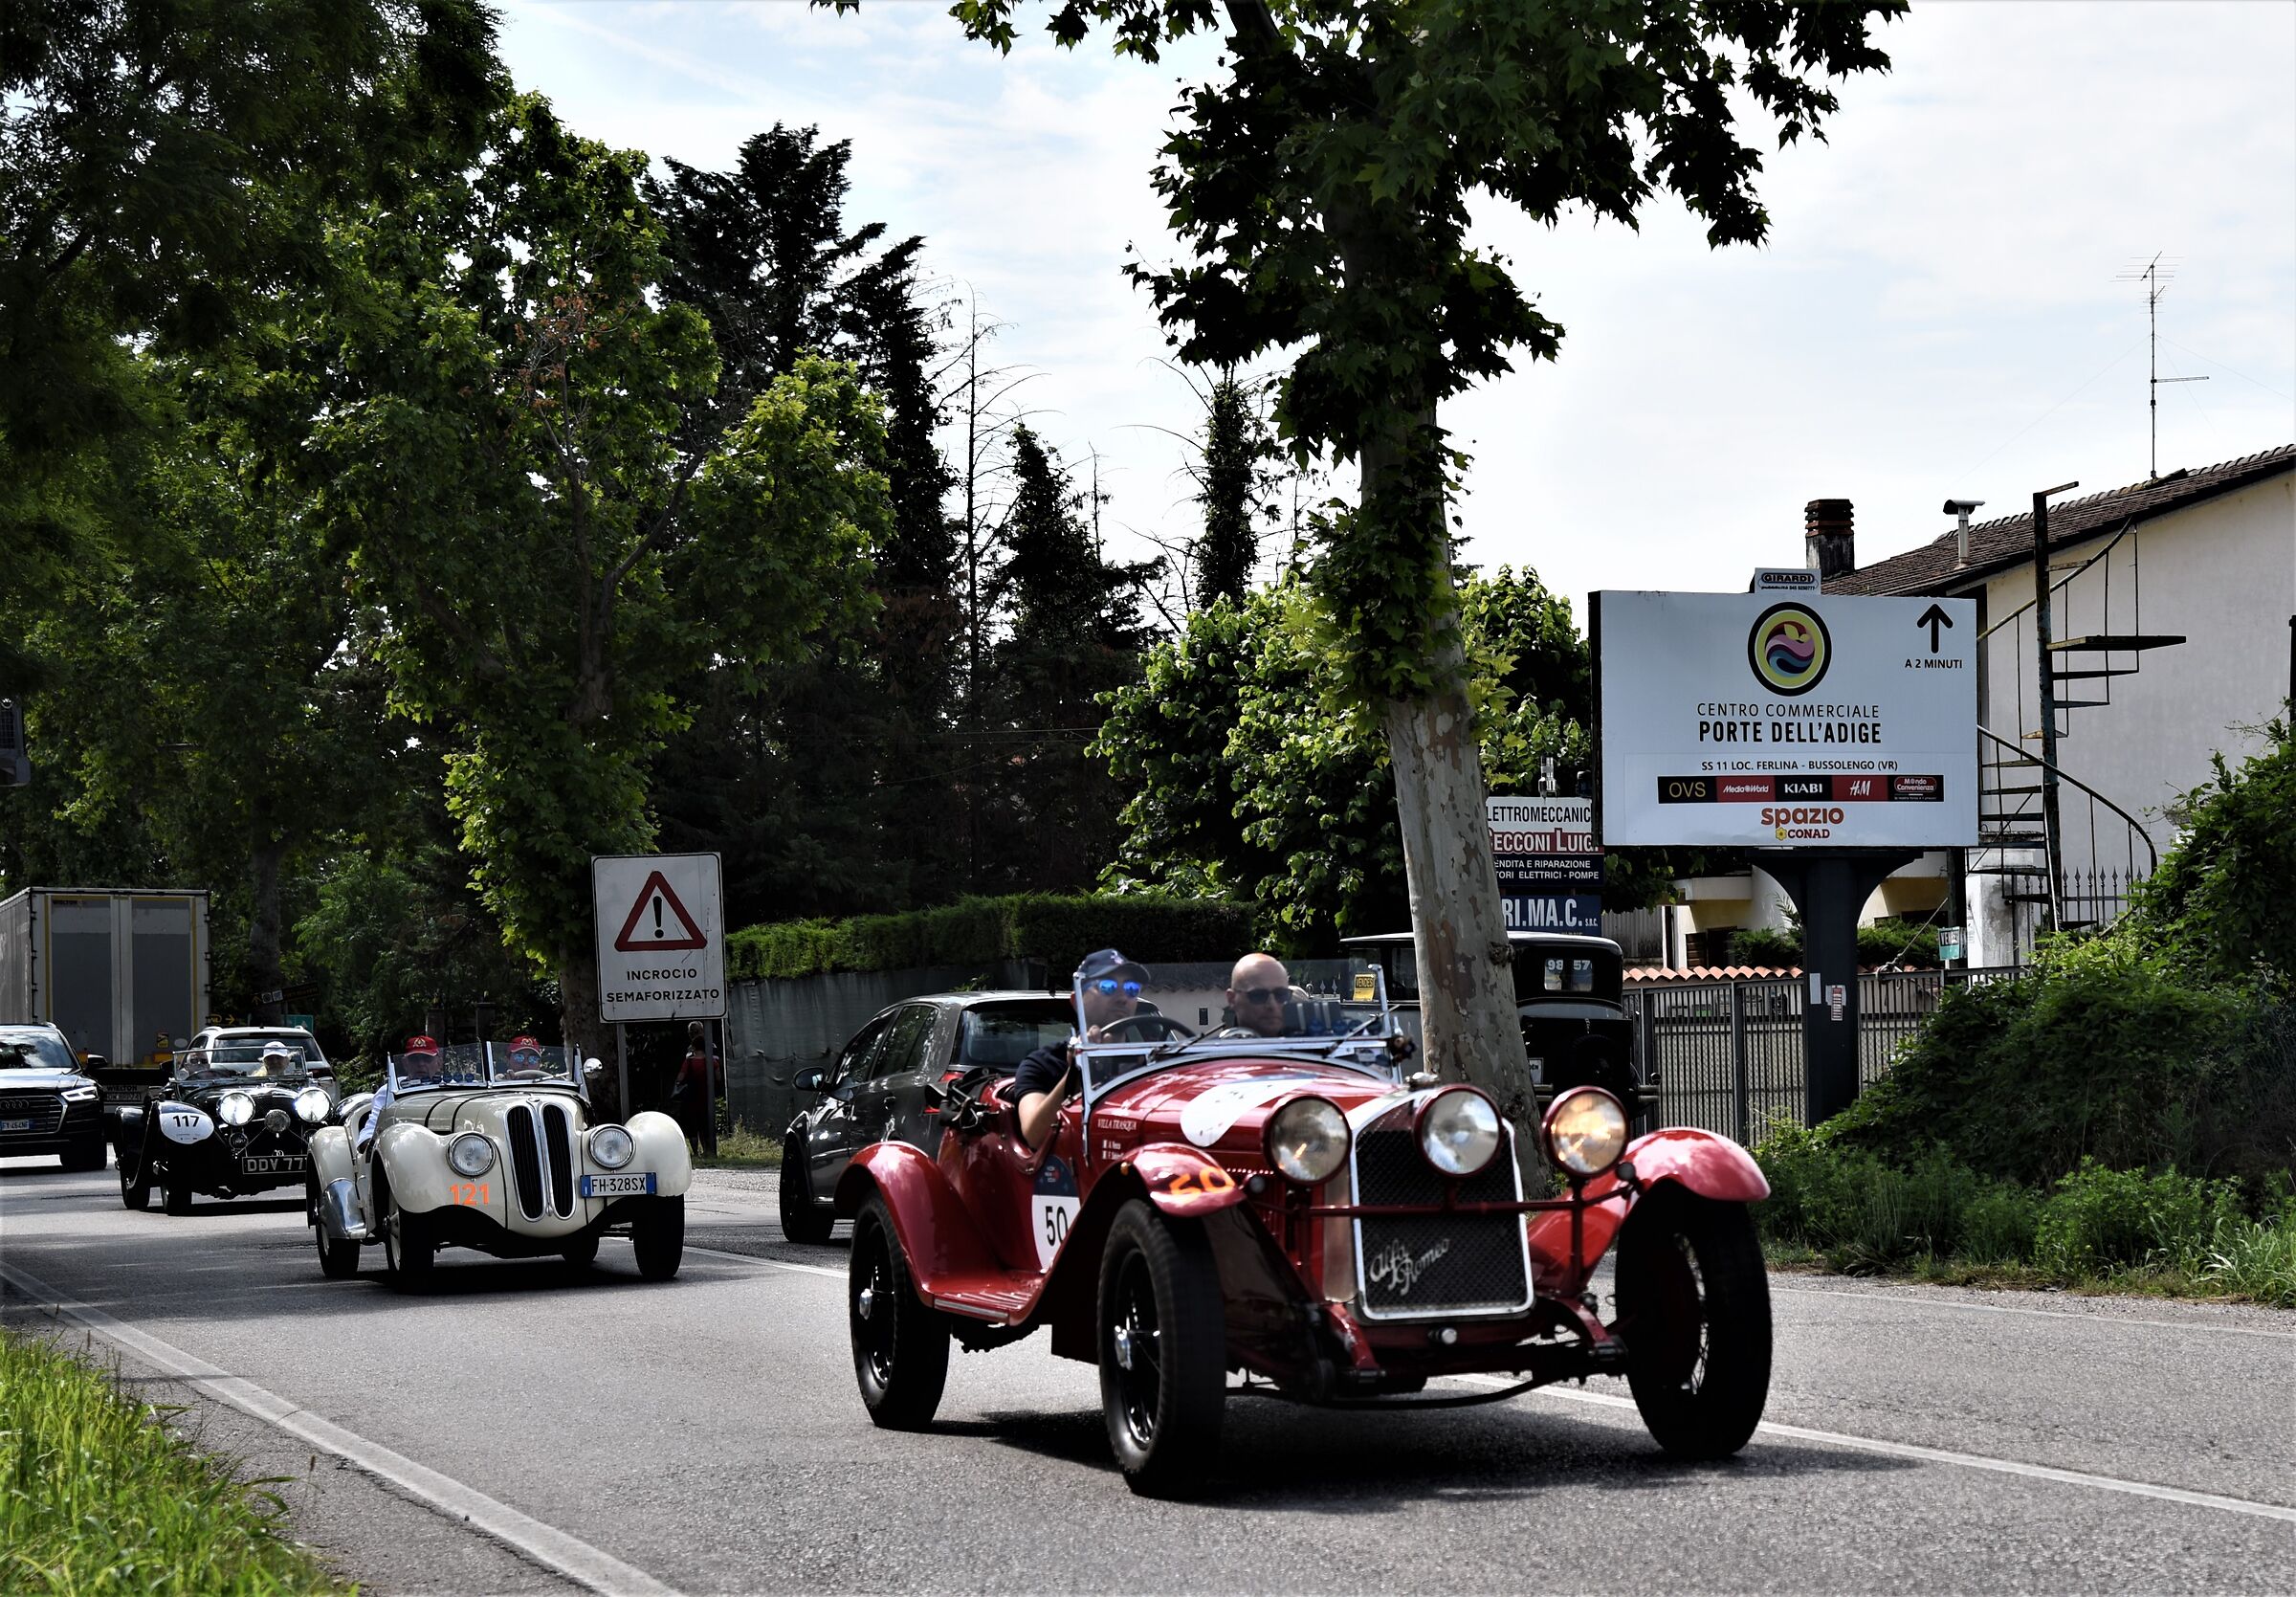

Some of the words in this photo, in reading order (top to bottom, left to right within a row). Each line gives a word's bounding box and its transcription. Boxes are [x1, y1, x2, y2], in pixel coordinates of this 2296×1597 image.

[1905, 659, 1912, 669] A
[1915, 659, 1921, 669] 2
[1925, 659, 1962, 669] MINUTI
[1697, 703, 1759, 717] CENTRO
[1766, 704, 1879, 718] COMMERCIALE
[1699, 721, 1763, 743] PORTE
[1772, 721, 1882, 743] DELL'ADIGE
[1702, 762, 1713, 770] SS
[1717, 762, 1728, 770] 11
[1732, 762, 1754, 770] LOC.
[1757, 761, 1799, 769] FERLINA
[1809, 761, 1874, 770] BUSSOLENGO
[1878, 761, 1898, 771] (VR)
[1669, 782, 1706, 798] OVS
[1784, 784, 1822, 793] KIABI
[1486, 807, 1591, 822] LETTROMECCANIC
[1761, 808, 1843, 829] spazio
[1489, 830, 1550, 852] ECCONI
[1556, 830, 1599, 852] LUIG
[1787, 829, 1830, 838] CONAD
[1519, 871, 1562, 879] ELETTRICI
[1569, 871, 1600, 879] POMPE
[1501, 898, 1583, 926] RI.MA.C.
[627, 968, 697, 981] INCROCIO
[607, 988, 719, 1003] SEMAFORIZZATO
[173, 1115, 200, 1127] 117
[247, 1159, 279, 1172] DDV
[282, 1158, 307, 1170] 77
[450, 1183, 489, 1206] 121
[1045, 1206, 1069, 1247] 50
